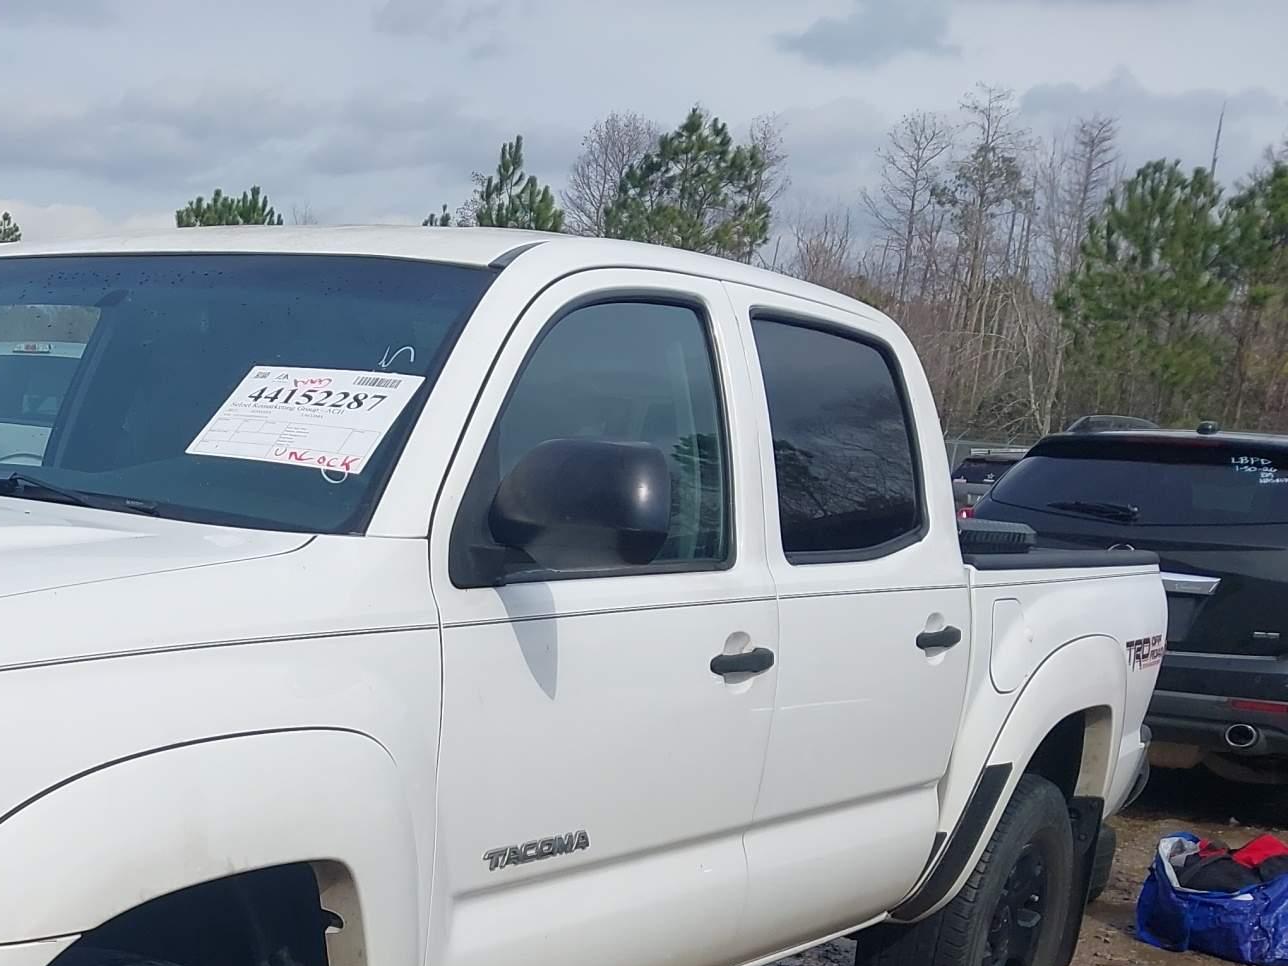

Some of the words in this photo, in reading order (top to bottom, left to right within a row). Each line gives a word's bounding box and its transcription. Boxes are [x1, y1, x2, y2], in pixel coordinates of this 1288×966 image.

[247, 386, 388, 412] 44152287
[1126, 637, 1151, 672] TRD
[482, 829, 590, 871] TACOMA
